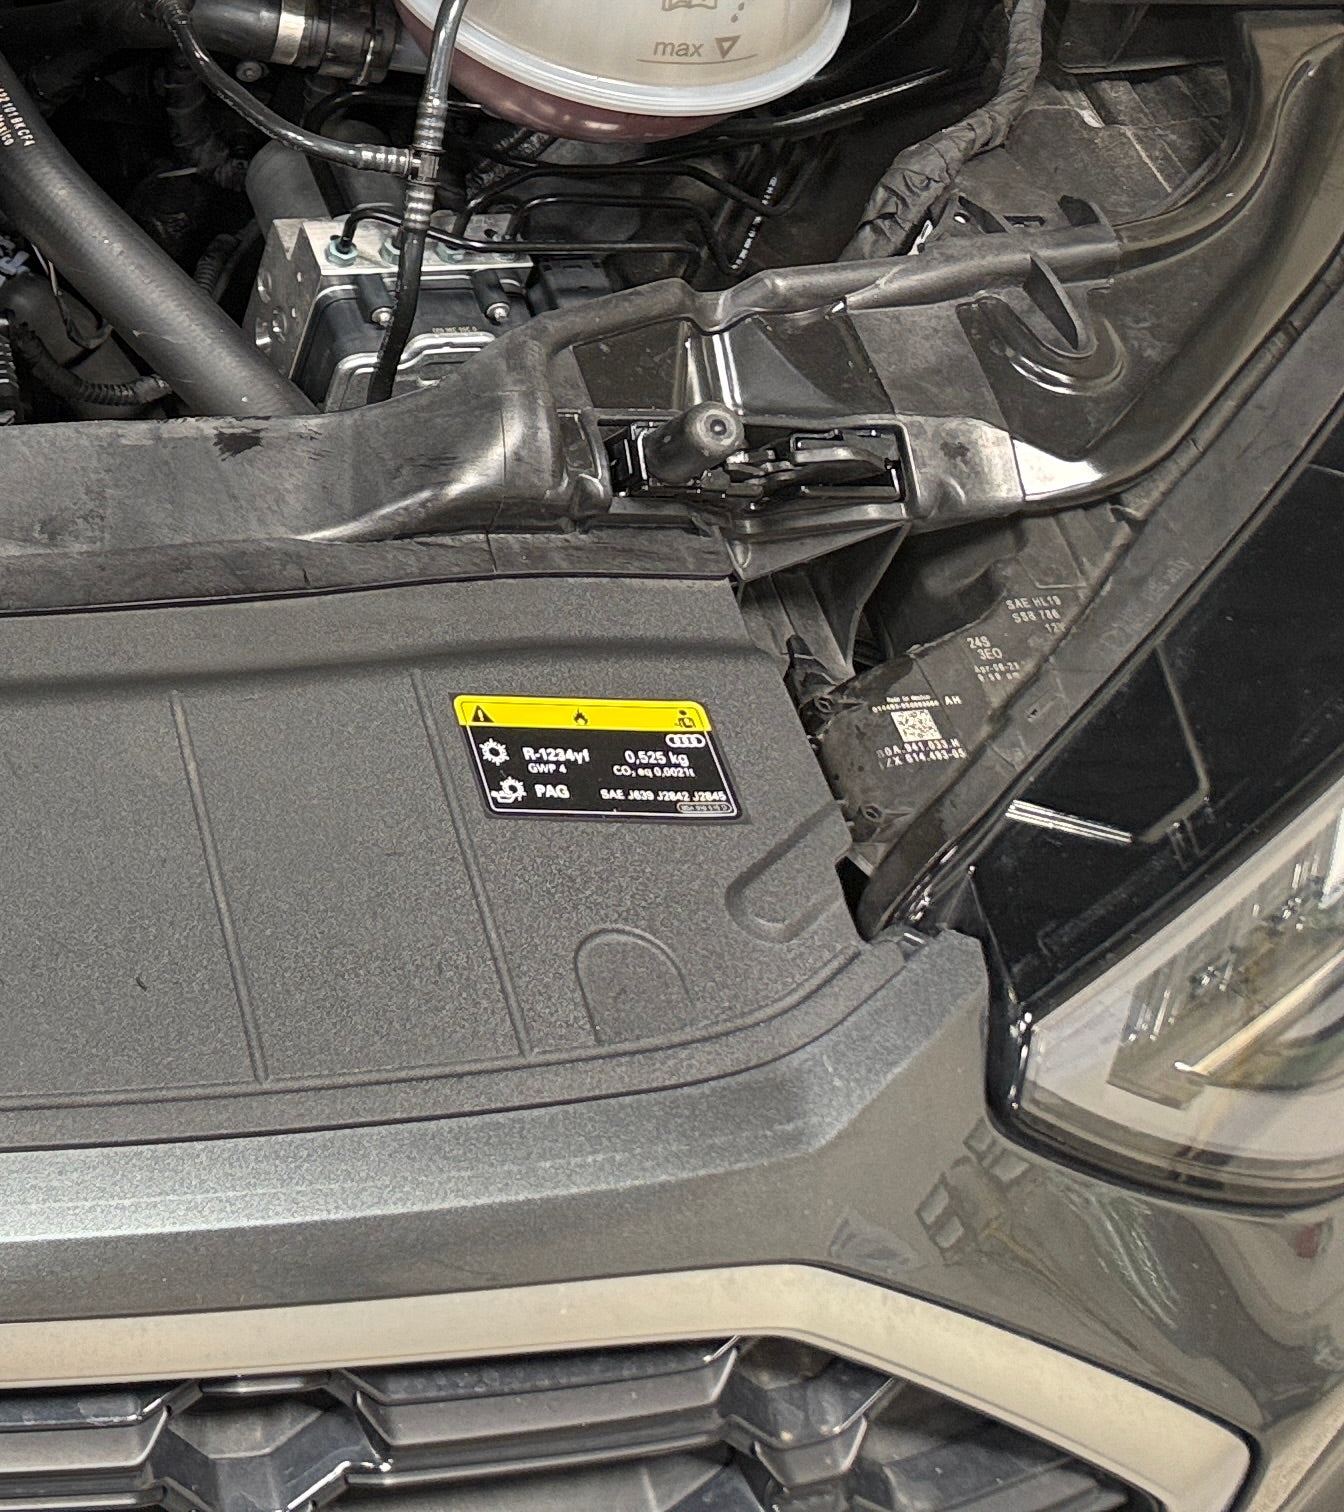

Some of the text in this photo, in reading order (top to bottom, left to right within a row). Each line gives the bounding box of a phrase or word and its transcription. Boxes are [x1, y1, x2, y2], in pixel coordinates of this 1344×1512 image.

[653, 41, 704, 58] max
[1005, 597, 1031, 610] SAE
[966, 635, 991, 649] 24S
[944, 695, 962, 706] AH
[522, 747, 590, 764] R-1234yf
[624, 750, 690, 767] 0,525 kg
[528, 763, 567, 775] GWP 4
[534, 784, 570, 799] PAG
[600, 789, 727, 802] SAE J639 J2842 J2845
